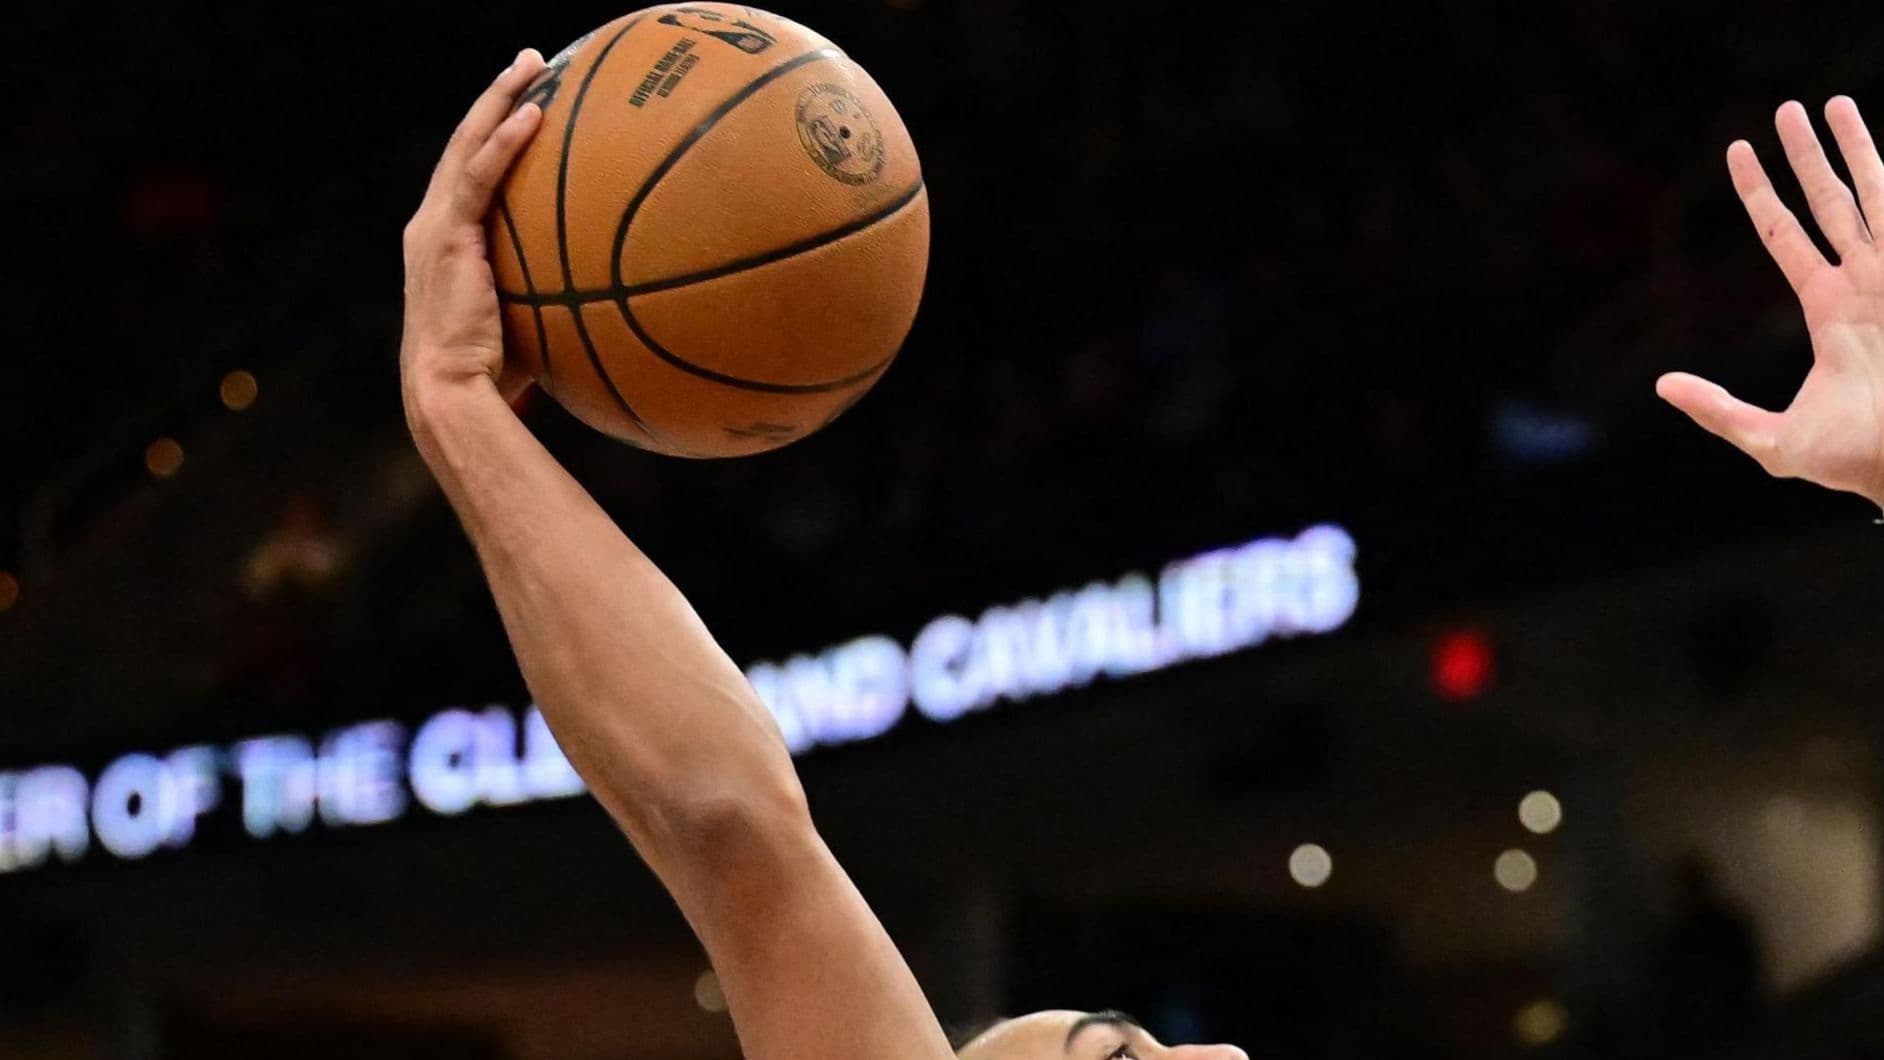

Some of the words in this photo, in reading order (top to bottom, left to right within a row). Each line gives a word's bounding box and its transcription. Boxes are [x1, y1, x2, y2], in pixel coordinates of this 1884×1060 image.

[93, 745, 222, 860] OF
[228, 717, 403, 841] THE
[908, 522, 1361, 724] CAVALIERS
